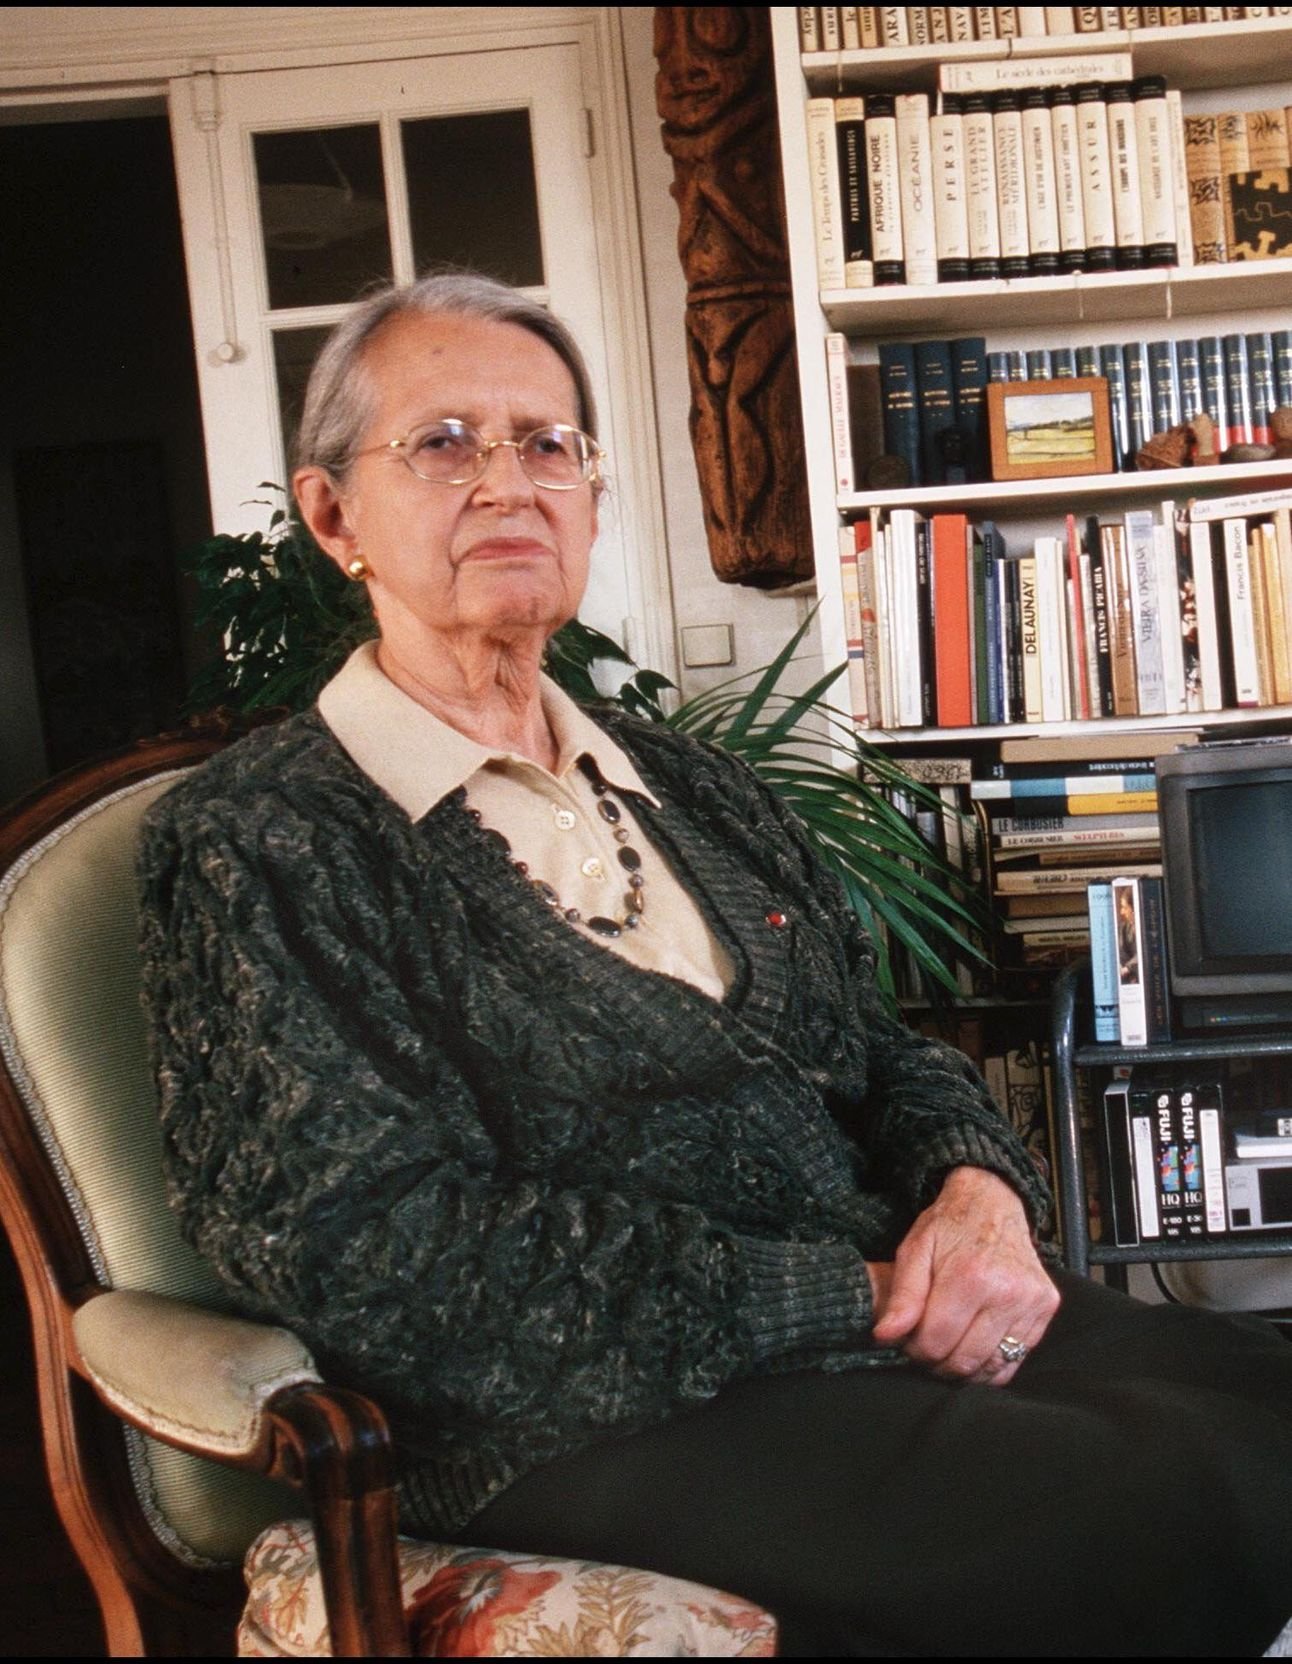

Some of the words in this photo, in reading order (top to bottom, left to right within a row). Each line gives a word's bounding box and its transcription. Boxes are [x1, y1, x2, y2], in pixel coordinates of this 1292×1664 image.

[870, 135, 882, 173] NOIRE
[942, 129, 956, 201] PERSE
[909, 135, 922, 213] OCÉANIE
[872, 180, 885, 233] AFRIQUE
[1232, 526, 1243, 559] Bacon
[1093, 566, 1105, 607] PICABIA
[1234, 563, 1245, 601] Francis
[1022, 581, 1037, 655] DELAUNAY
[1096, 610, 1108, 653] FRANCIS
[1138, 600, 1152, 644] VIEIRA
[997, 819, 1009, 833] LE
[1158, 1109, 1172, 1141] FUJI
[1181, 1107, 1195, 1139] FUJI
[1161, 1193, 1180, 1206] HQ
[1184, 1191, 1203, 1204] HQ
